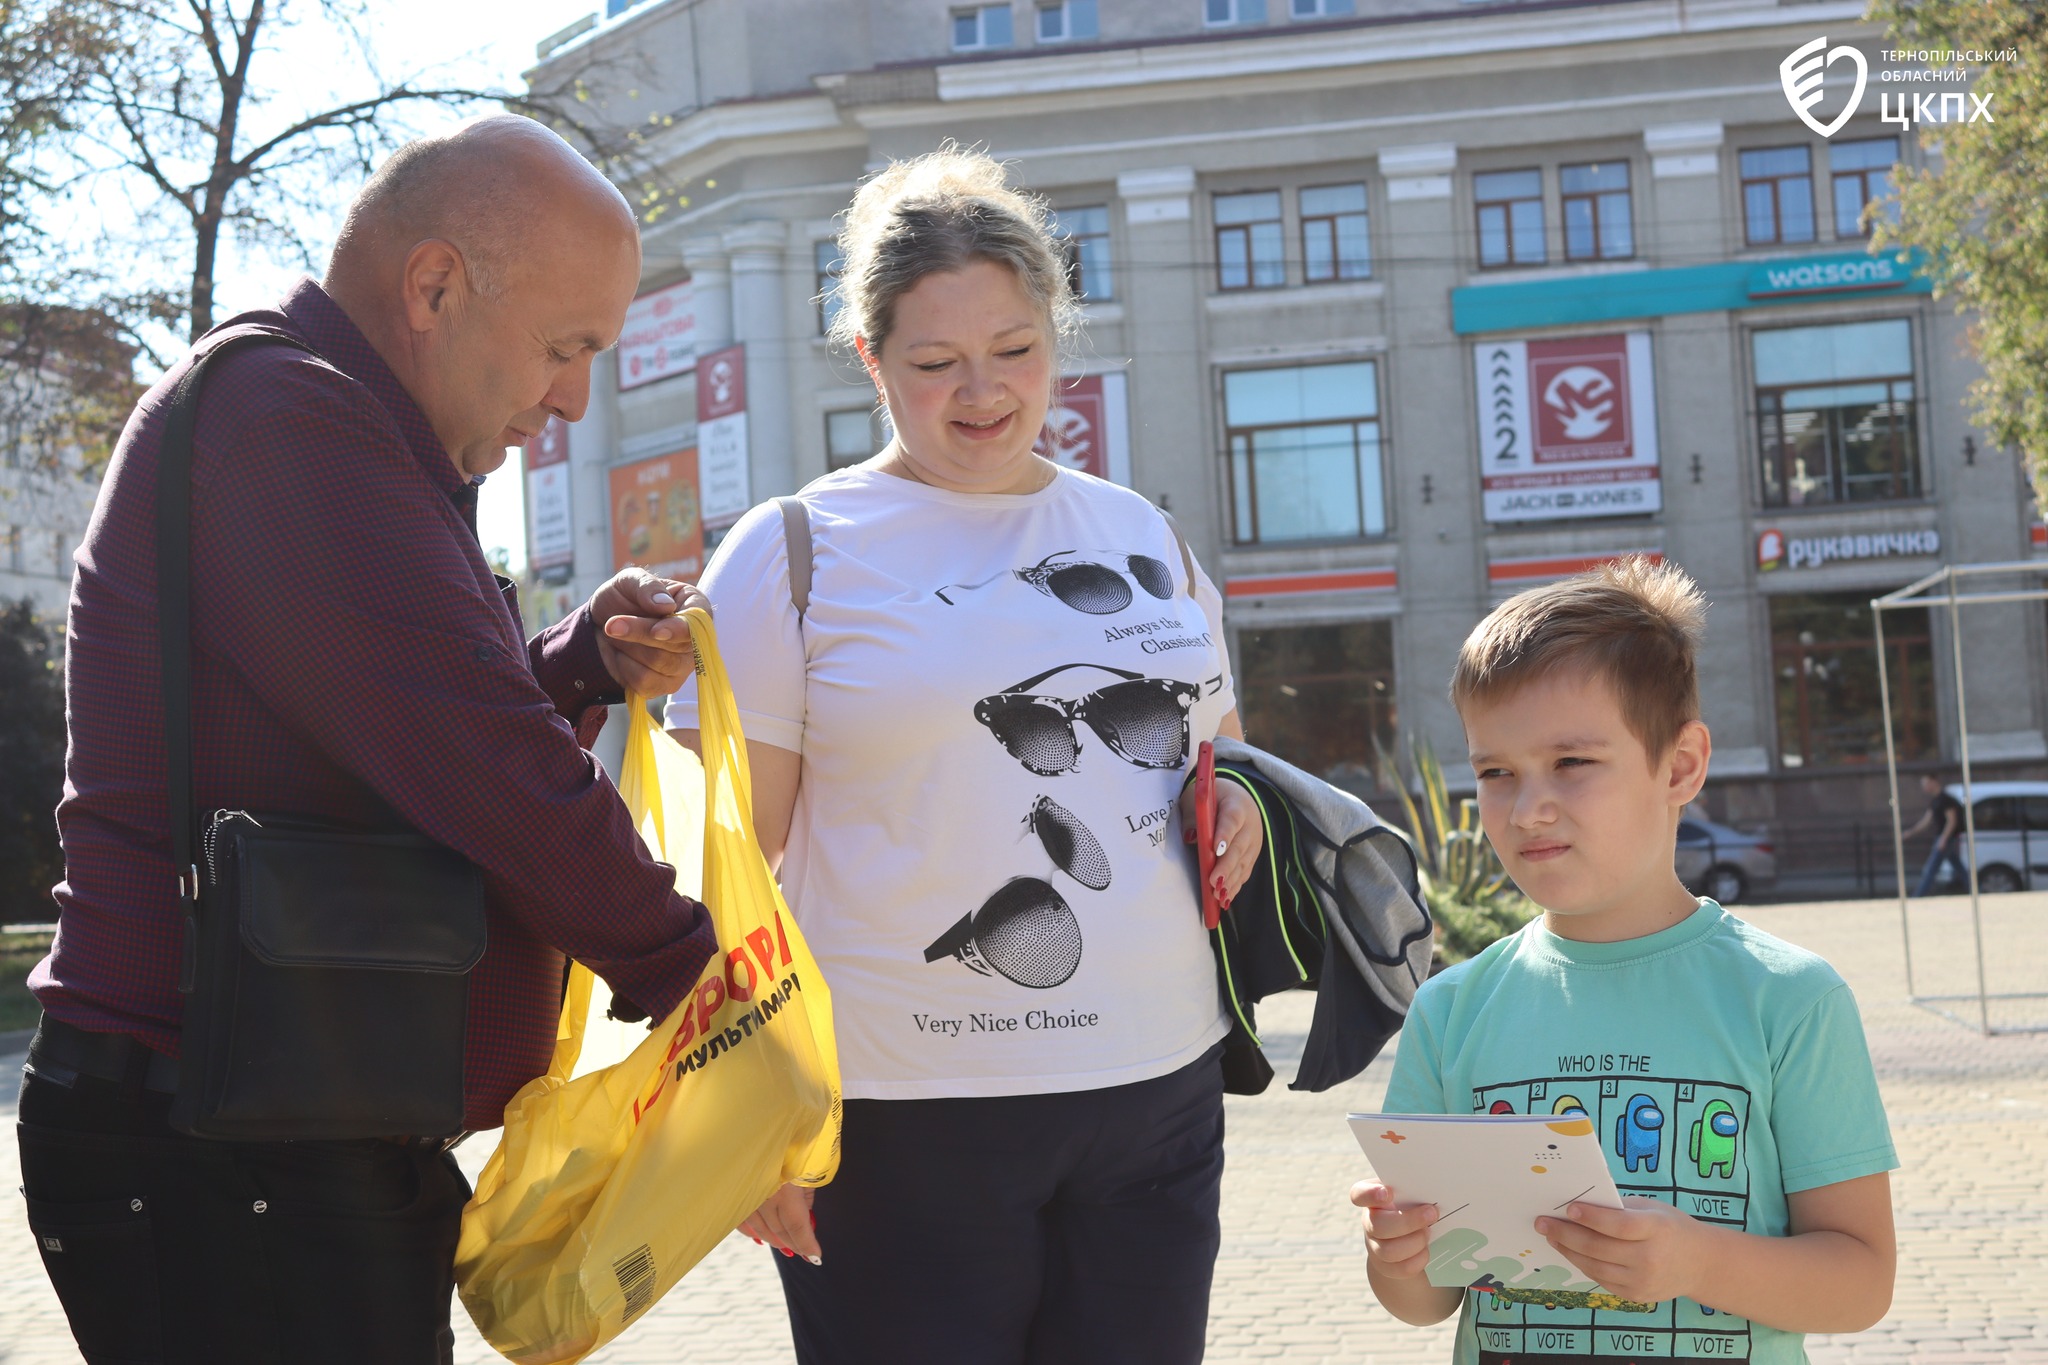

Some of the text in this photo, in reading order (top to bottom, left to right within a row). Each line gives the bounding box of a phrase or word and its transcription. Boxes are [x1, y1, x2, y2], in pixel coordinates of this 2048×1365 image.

[1768, 259, 1893, 288] watsons
[1495, 427, 1518, 460] 2
[1501, 493, 1553, 512] JACK
[1576, 487, 1643, 507] JONES
[1788, 529, 1940, 569] рукавичка
[1104, 617, 1184, 643] Always the
[1140, 634, 1205, 655] Classiest
[1124, 808, 1168, 834] Love
[912, 1009, 1099, 1038] Very Nice Choice
[1558, 1054, 1651, 1073] WHO IS THE
[1534, 1084, 1542, 1097] 2
[1605, 1082, 1613, 1094] 3
[1681, 1086, 1689, 1098] 4
[1692, 1197, 1730, 1216] VOTE
[1485, 1331, 1511, 1349] VOTE
[1536, 1332, 1575, 1350] VOTE
[1610, 1334, 1655, 1352] VOTE
[1693, 1336, 1735, 1354] VOTE
